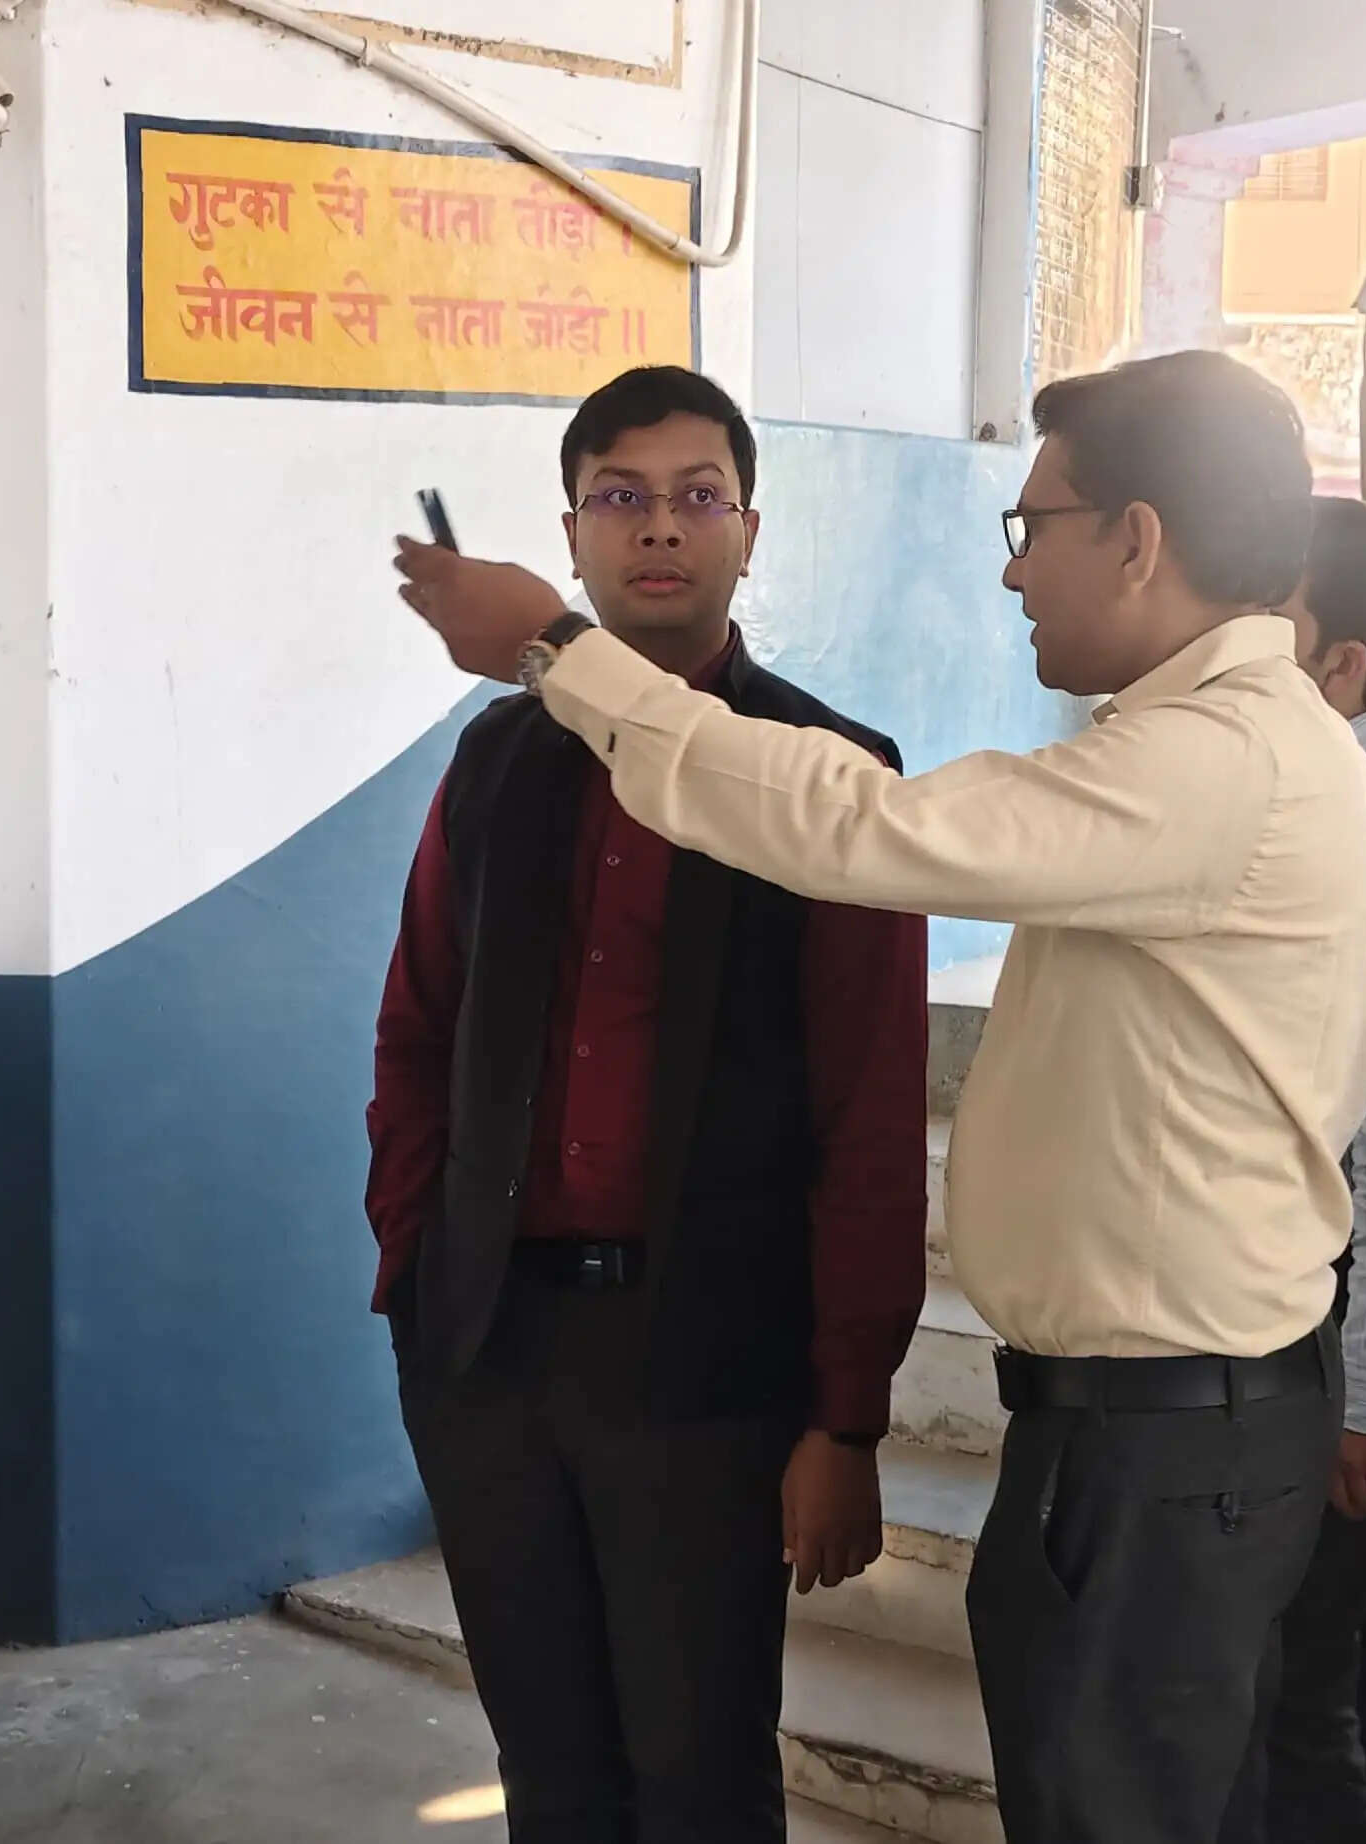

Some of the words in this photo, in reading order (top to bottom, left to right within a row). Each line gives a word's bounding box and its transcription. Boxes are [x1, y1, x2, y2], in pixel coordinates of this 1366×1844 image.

[166, 172, 296, 251] गुटका
[312, 167, 369, 238] से
[389, 187, 497, 245] नाता
[176, 265, 317, 346] जीवन
[327, 270, 392, 348] से
[409, 296, 505, 349] नाता
